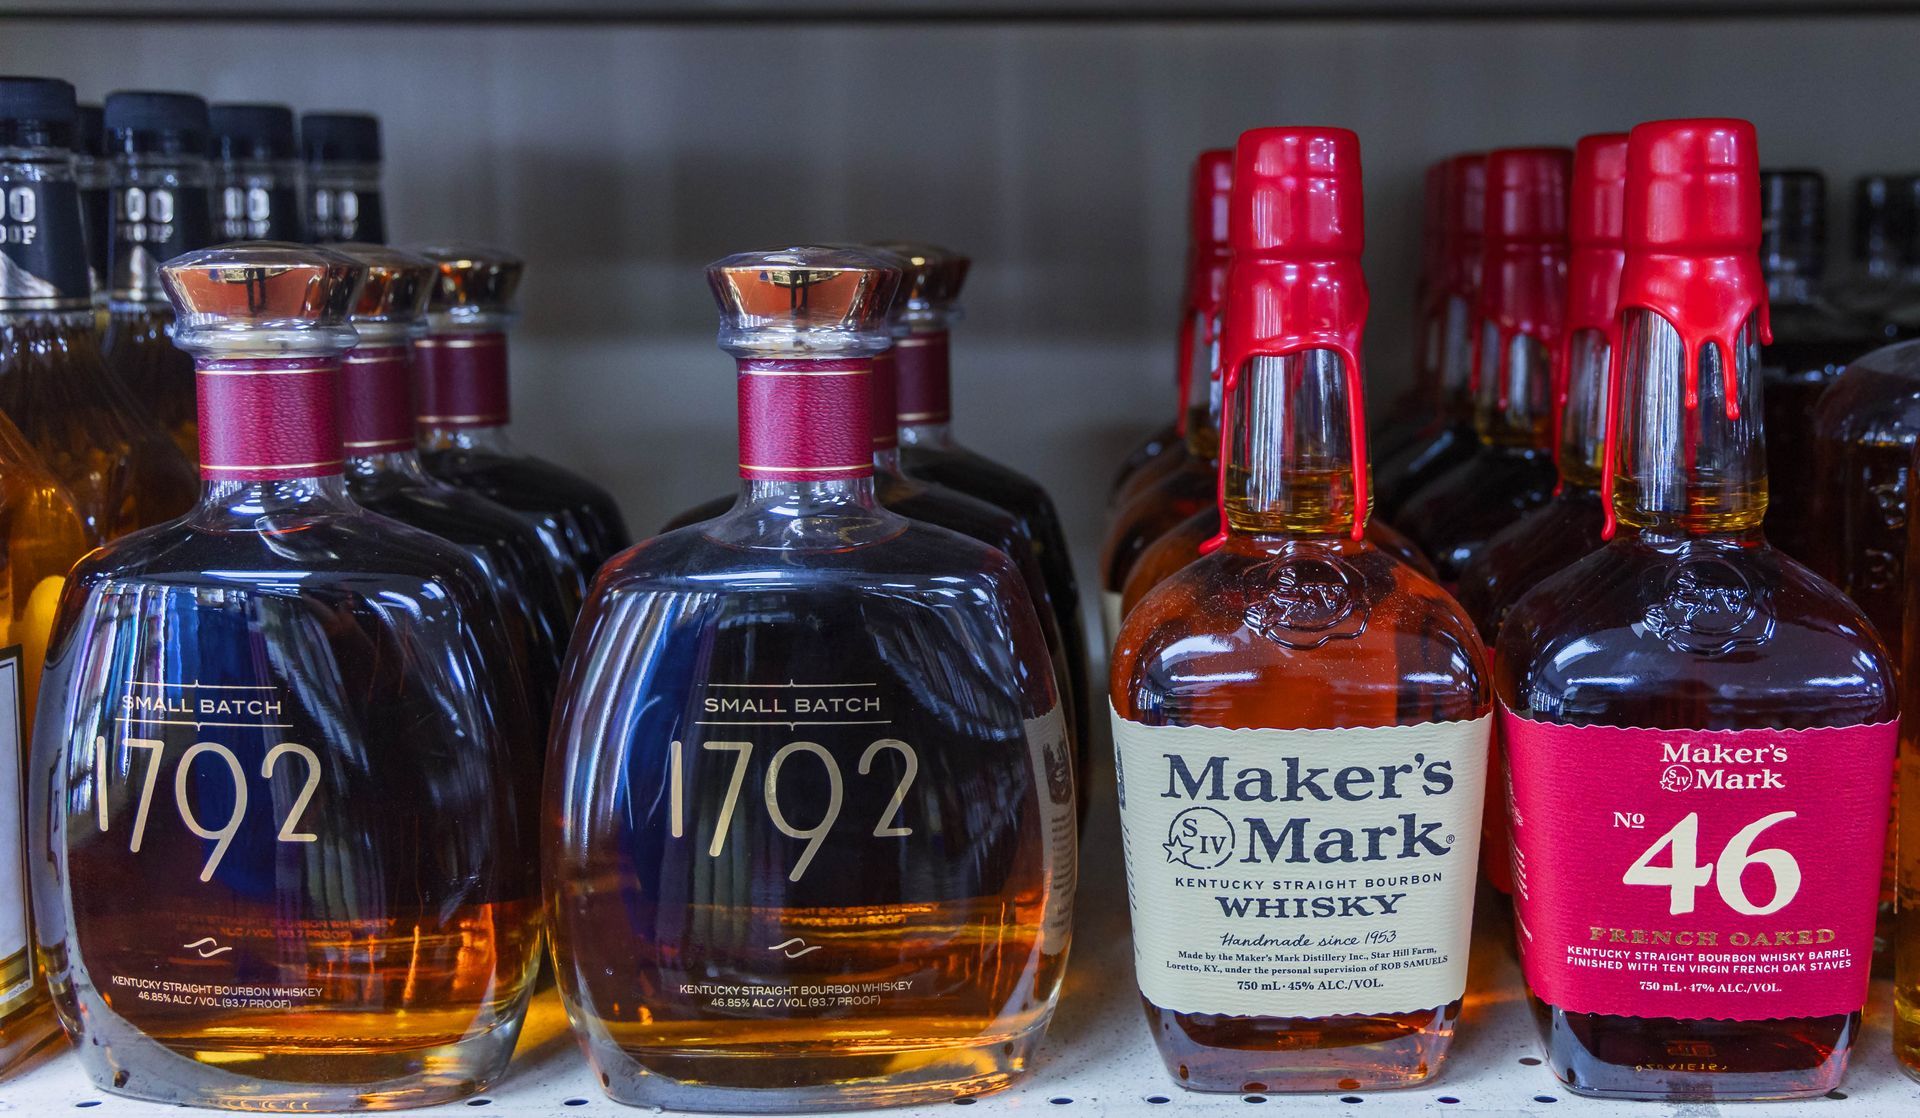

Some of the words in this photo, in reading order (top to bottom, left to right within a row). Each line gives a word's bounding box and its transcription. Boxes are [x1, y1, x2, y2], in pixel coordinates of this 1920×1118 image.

[122, 695, 194, 714] SMALL
[200, 700, 282, 715] BATCH
[704, 697, 786, 713] SMALL
[796, 697, 880, 713] BATCH
[1659, 743, 1788, 764] Maker's
[1161, 752, 1455, 803] Maker's
[1695, 769, 1785, 790] Mark
[95, 736, 322, 882] 1792
[670, 738, 918, 883] 1792
[1622, 811, 1802, 916] 46
[1175, 877, 1265, 890] KENTUCKY
[1273, 877, 1357, 890] STRAIGHT
[1365, 872, 1443, 888] BOURBON
[1215, 893, 1407, 919] WHISKY
[1220, 932, 1314, 948] Handmade
[1318, 934, 1360, 947] since
[1364, 930, 1397, 945] 1953
[1589, 927, 1719, 946] FRENCH
[1730, 928, 1836, 946] OAKED
[1178, 950, 1202, 960] Made
[1204, 951, 1216, 963] by
[1217, 952, 1233, 961] the
[1235, 952, 1272, 962] Maker's
[1274, 952, 1300, 962] Mark
[1302, 951, 1347, 964] Distillery
[1370, 950, 1391, 960] Star
[1393, 948, 1410, 958] Hill
[1412, 947, 1437, 958] Farm,
[1567, 946, 1631, 960] KENTUCKY
[1634, 949, 1695, 962] STRAIGHT
[1698, 951, 1756, 963] BOURBON
[1760, 951, 1804, 962] WHISKY
[1808, 948, 1852, 960] BARREL
[1165, 961, 1202, 973] Loretto,
[1225, 965, 1252, 975] under
[1254, 965, 1269, 975] the
[1272, 965, 1310, 977] personal
[1312, 964, 1368, 977] supervision
[1369, 963, 1379, 972] of
[1380, 960, 1402, 971] ROB
[1403, 955, 1448, 969] SAMUELS
[1567, 957, 1623, 970] FINISHED
[1627, 961, 1658, 972] WITH
[1661, 963, 1685, 972] TEN
[1688, 963, 1729, 974] VIRGIN
[1732, 963, 1779, 974] FRENCH
[1782, 962, 1806, 972] OAK
[1810, 958, 1852, 970] STAVES
[112, 975, 162, 991] KENTUCKY
[162, 982, 212, 995] STRAIGHT
[213, 986, 272, 997] BOURBON
[272, 987, 323, 998] WHISKEY
[679, 984, 740, 996] KENTUCKY
[741, 985, 798, 996] STRAIGHT
[800, 984, 860, 995] BOURBON
[862, 981, 913, 992] WHISKEY
[1237, 980, 1258, 991] 750
[1317, 978, 1384, 991] ALC./VOL.
[1639, 981, 1660, 991] 750
[1718, 981, 1782, 993] ALC./VOL.
[138, 991, 171, 1004] 46.85%
[172, 994, 191, 1006] ALC
[199, 997, 222, 1007] VOL
[222, 997, 247, 1009] (93.7
[249, 999, 292, 1009] PROOF)
[711, 998, 750, 1008] 46.85%
[752, 998, 775, 1008] ALC
[783, 998, 807, 1008] VOL
[808, 997, 836, 1009] (93.7
[837, 995, 881, 1006] PROOF)
